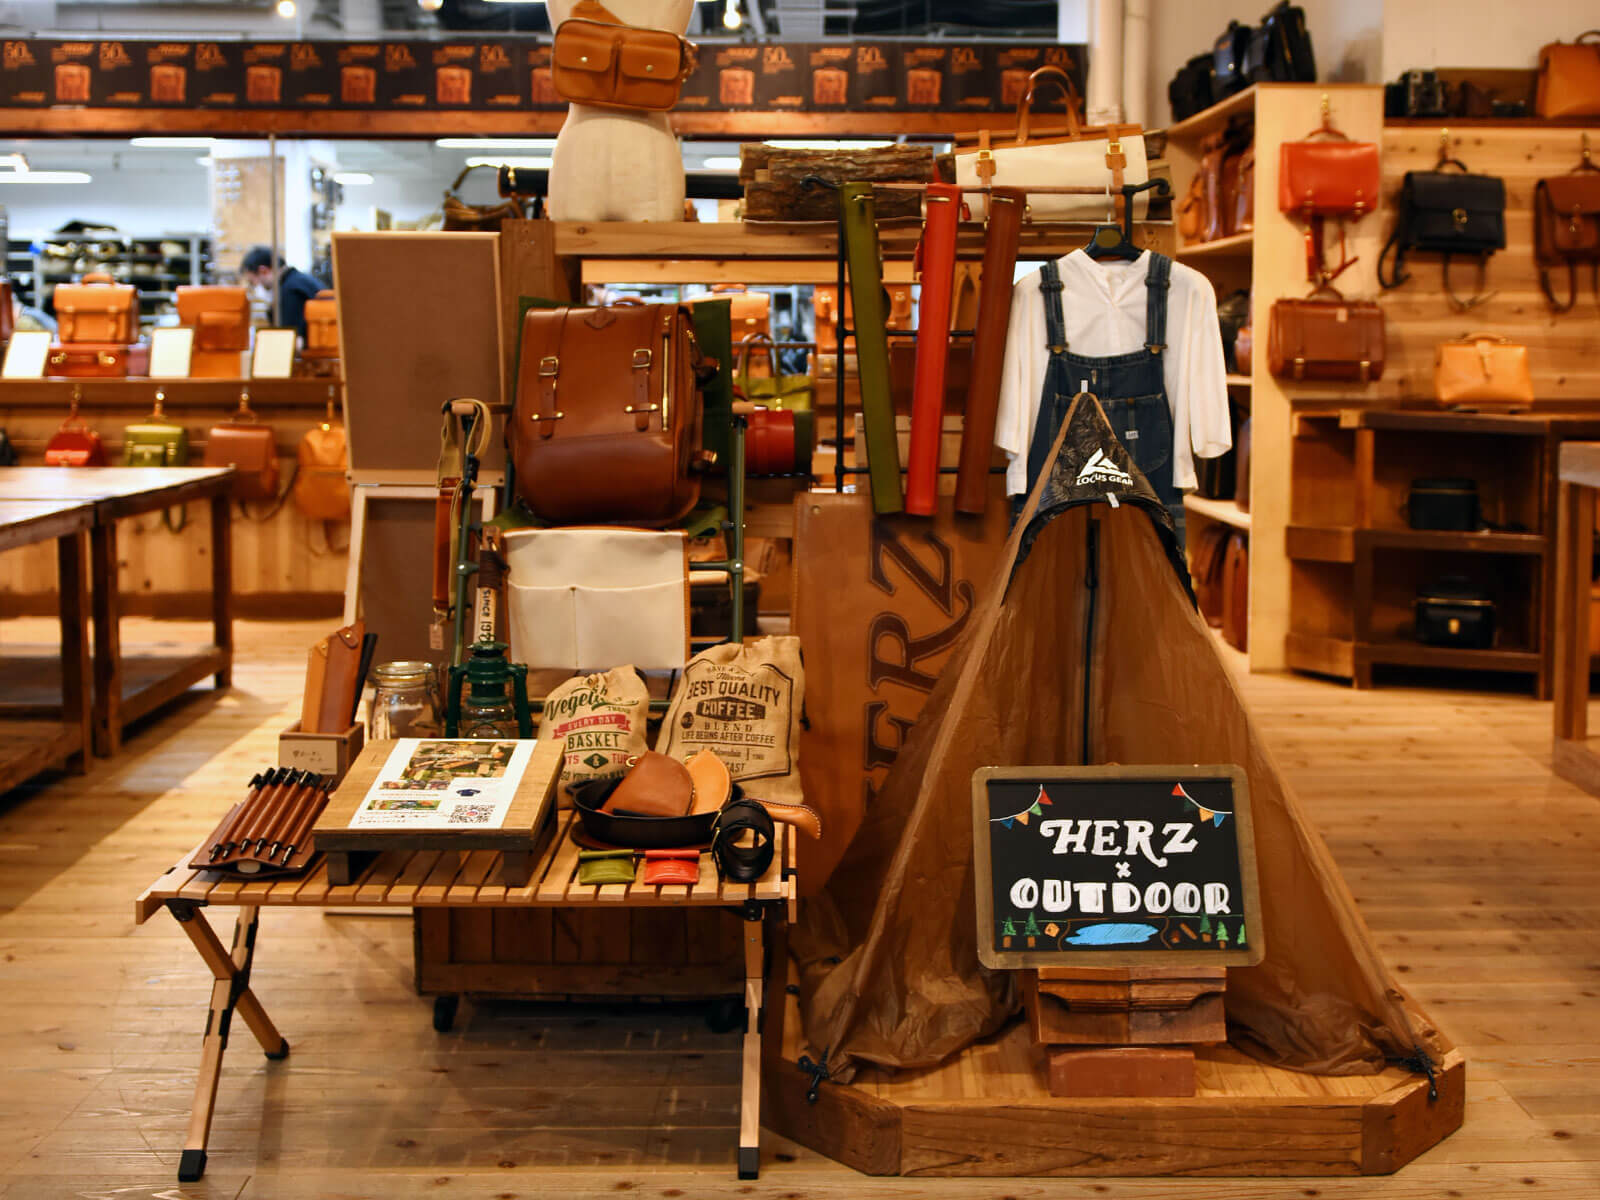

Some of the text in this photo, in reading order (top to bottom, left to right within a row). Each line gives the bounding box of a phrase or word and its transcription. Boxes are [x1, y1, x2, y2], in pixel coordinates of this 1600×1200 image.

[1076, 473, 1134, 487] LOCUS GEAR
[687, 681, 780, 706] BEST QUALITY
[703, 701, 757, 719] COFFEE
[568, 716, 617, 729] EVERY DAY
[704, 721, 753, 733] BLEND
[568, 733, 619, 750] BASKET
[682, 730, 775, 744] LIFE BEGINS AFTER COFFEE
[1039, 819, 1198, 867] HERZ
[1010, 878, 1231, 914] OUTDOOR
